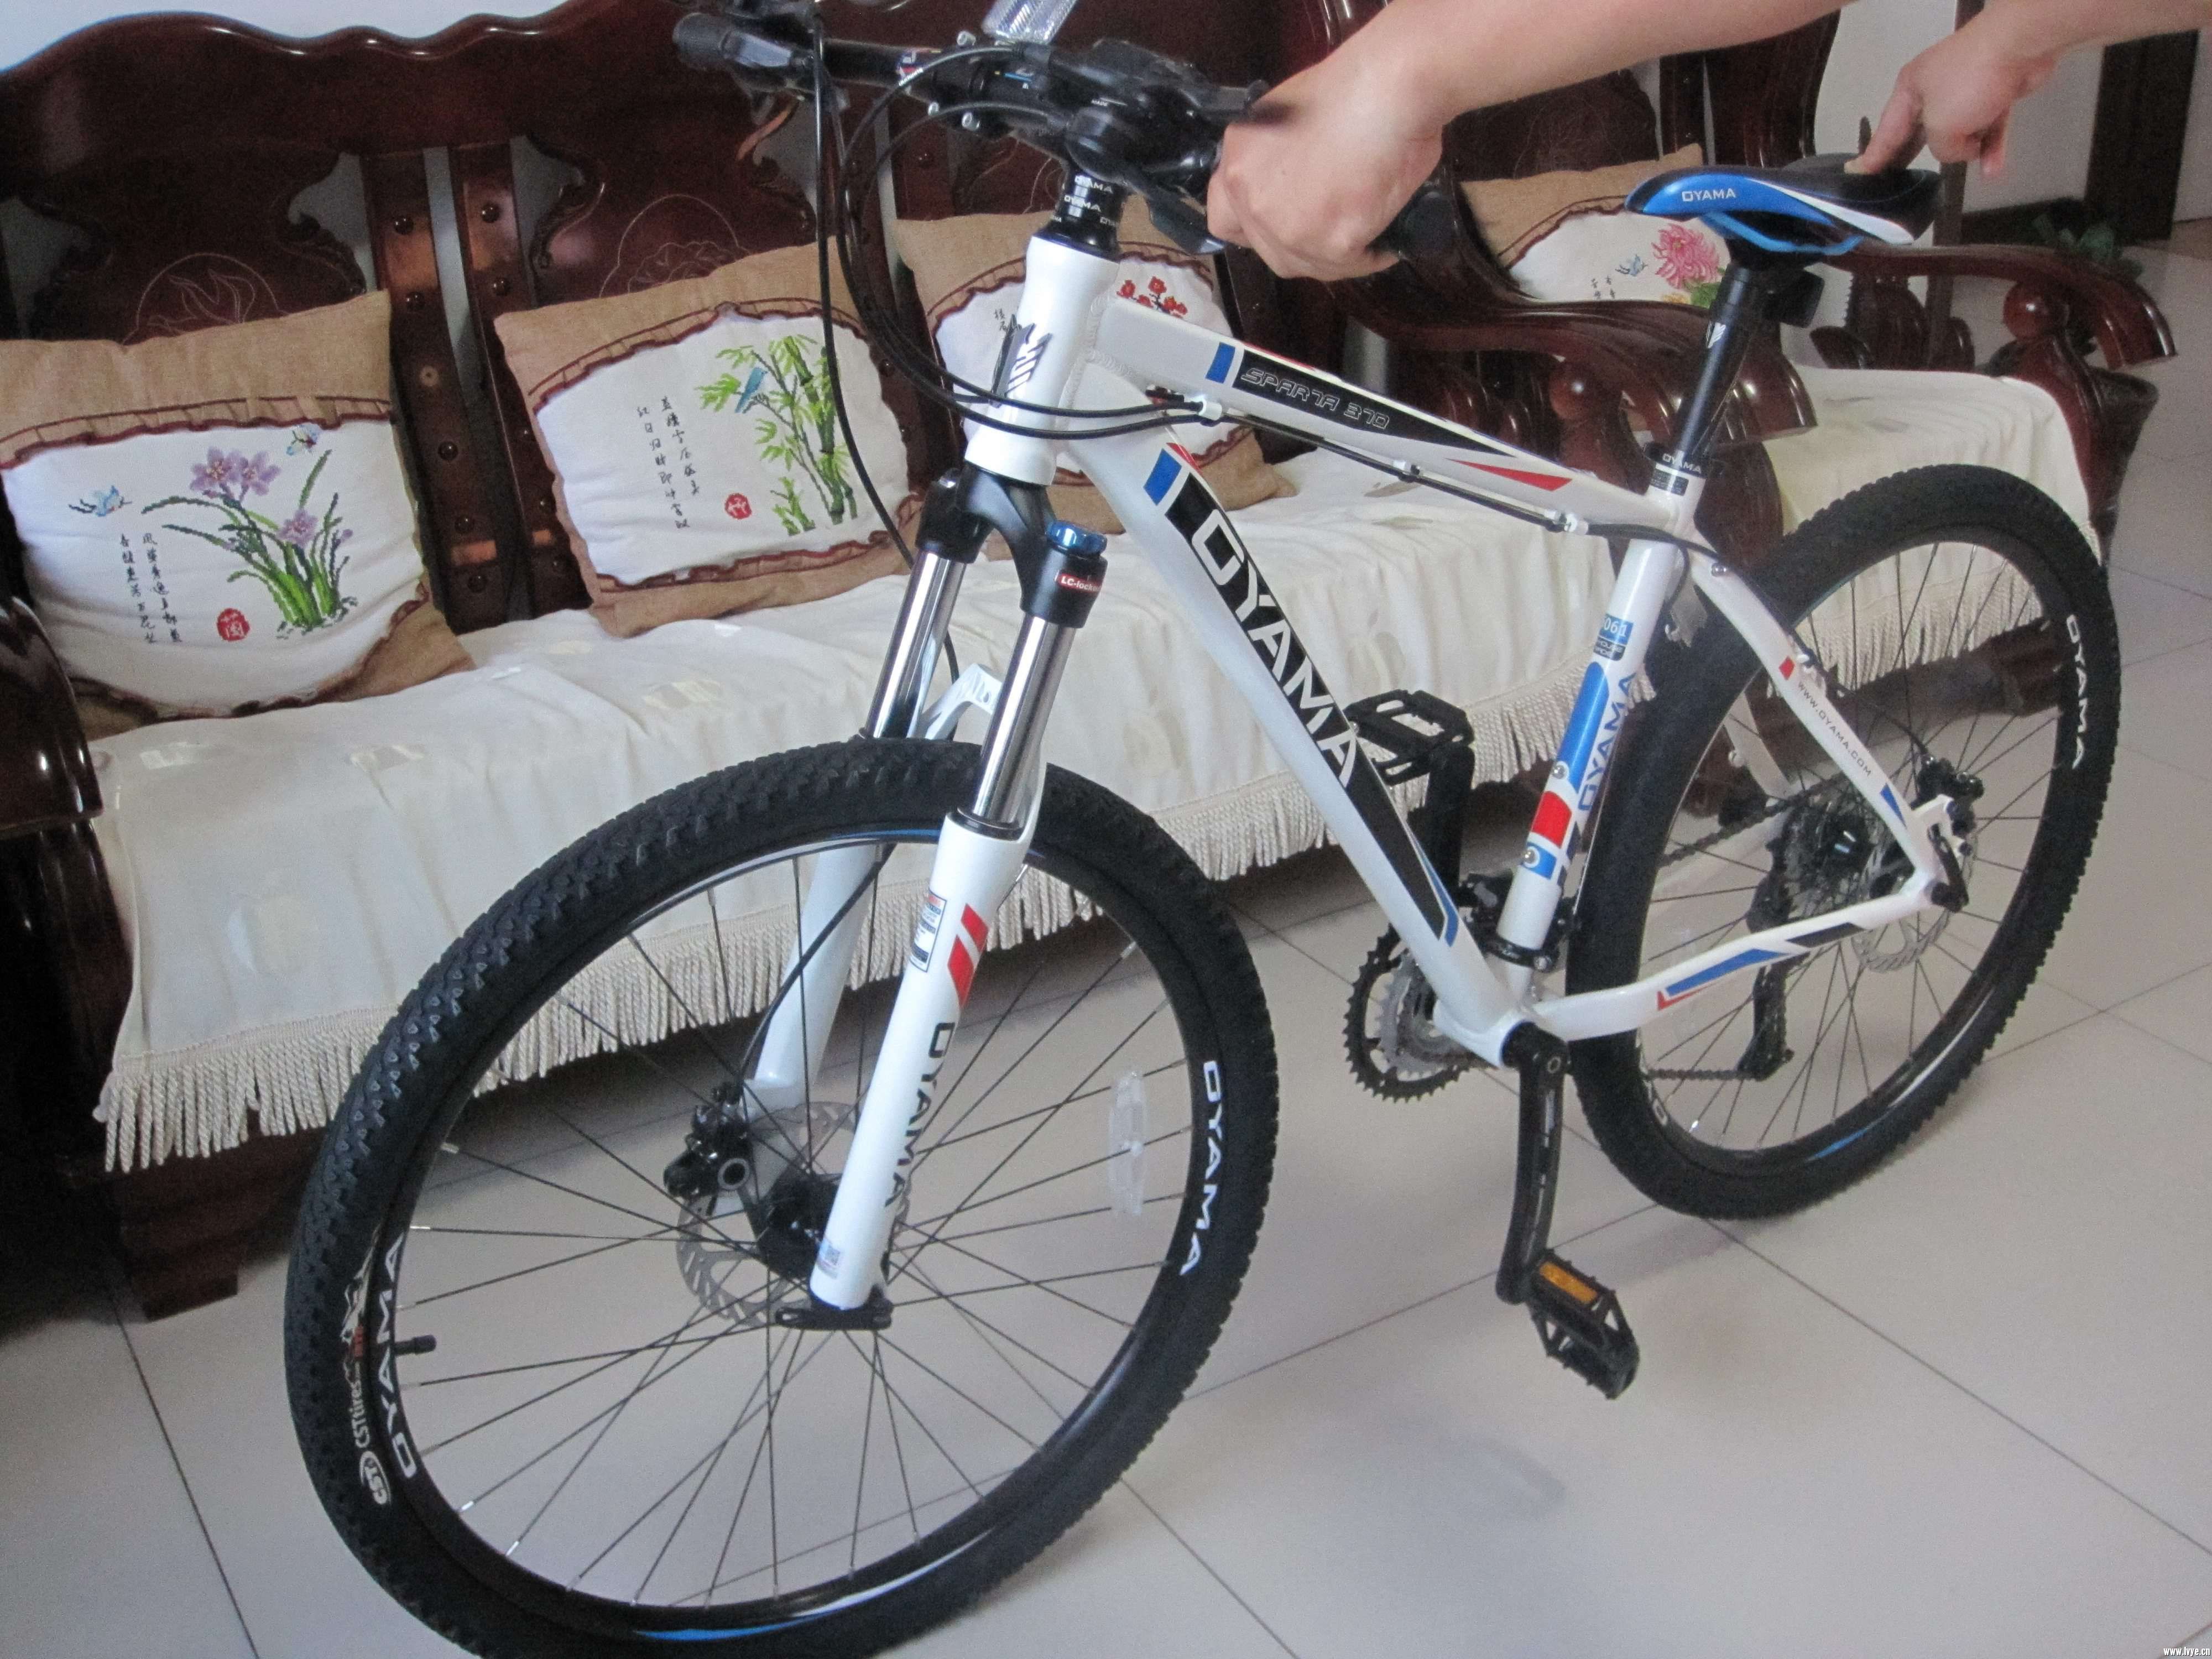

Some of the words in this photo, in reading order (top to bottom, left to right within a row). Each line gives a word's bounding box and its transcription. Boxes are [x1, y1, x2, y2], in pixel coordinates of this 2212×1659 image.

[1682, 188, 1736, 202] OYAMA
[1241, 367, 1339, 411] SPARTA
[1344, 403, 1390, 429] 370
[1662, 453, 1702, 474] OYAMA
[1192, 508, 1357, 787] OYAMA
[1603, 615, 1629, 637] 061
[2066, 614, 2088, 769] OYAMA
[1577, 674, 1636, 811] OYAMA
[1798, 681, 1871, 776] WWW.OYAMA.COM
[885, 1022, 955, 1208] OYAMA
[1180, 1060, 1223, 1276] OYAMA
[377, 1232, 416, 1478] OYAMA
